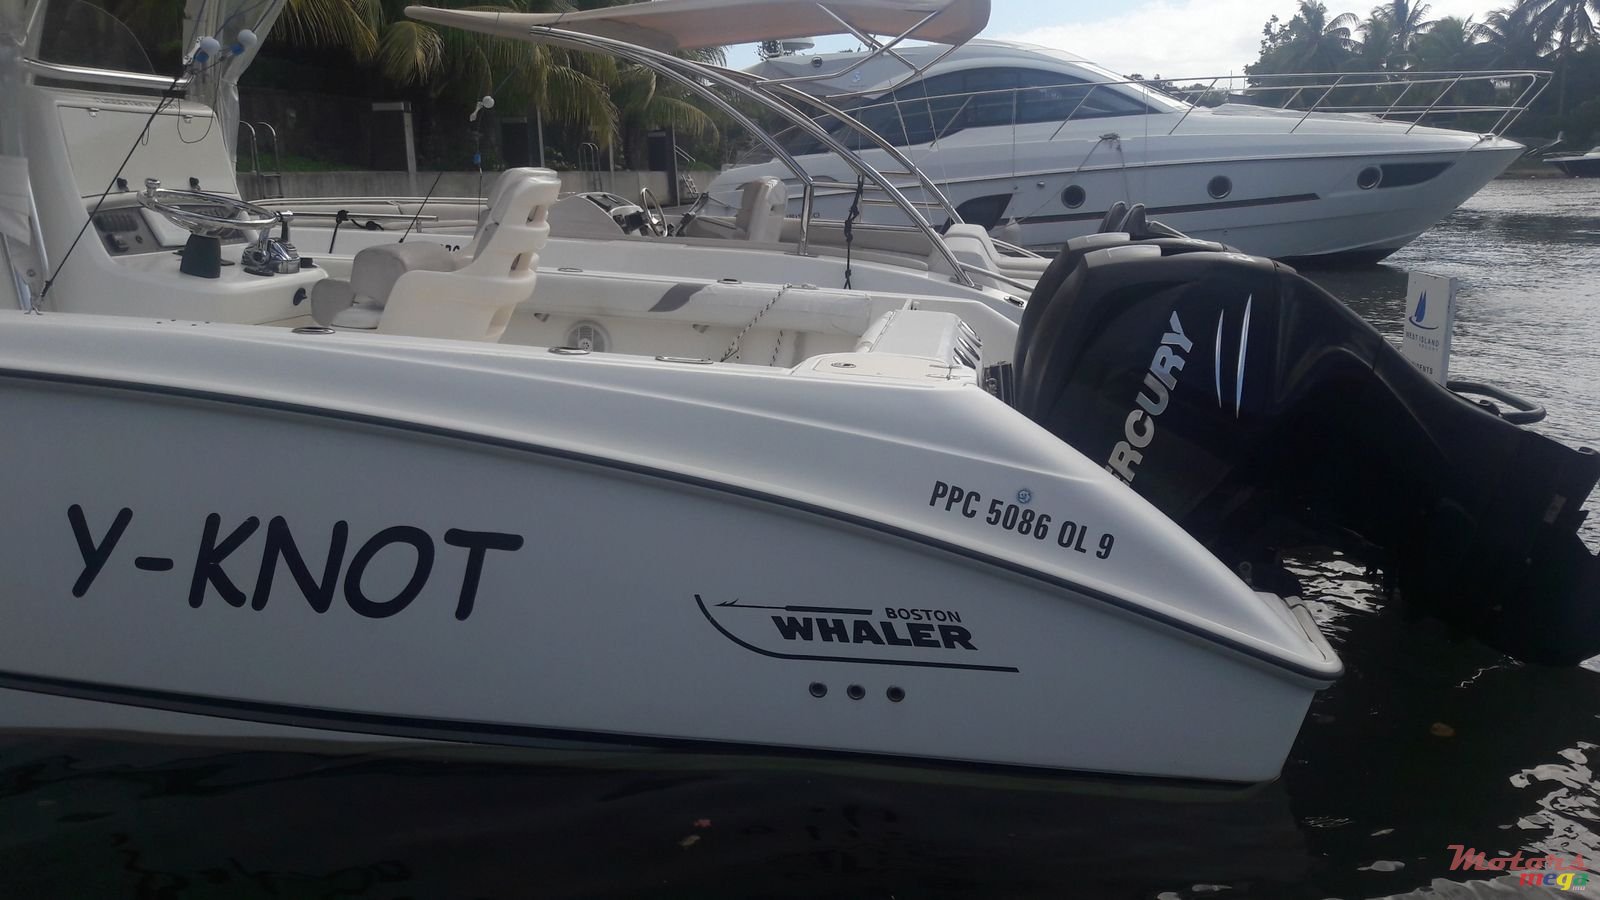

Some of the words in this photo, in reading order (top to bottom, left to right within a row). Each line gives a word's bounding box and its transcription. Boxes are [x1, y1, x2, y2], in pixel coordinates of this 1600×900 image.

[1419, 335, 1440, 347] ISLAND
[1105, 311, 1193, 486] RCURY
[929, 480, 981, 518] PPC
[986, 498, 1051, 540] 5086
[1096, 533, 1115, 560] 9
[771, 615, 979, 651] WHALER
[885, 607, 962, 624] BOSTON
